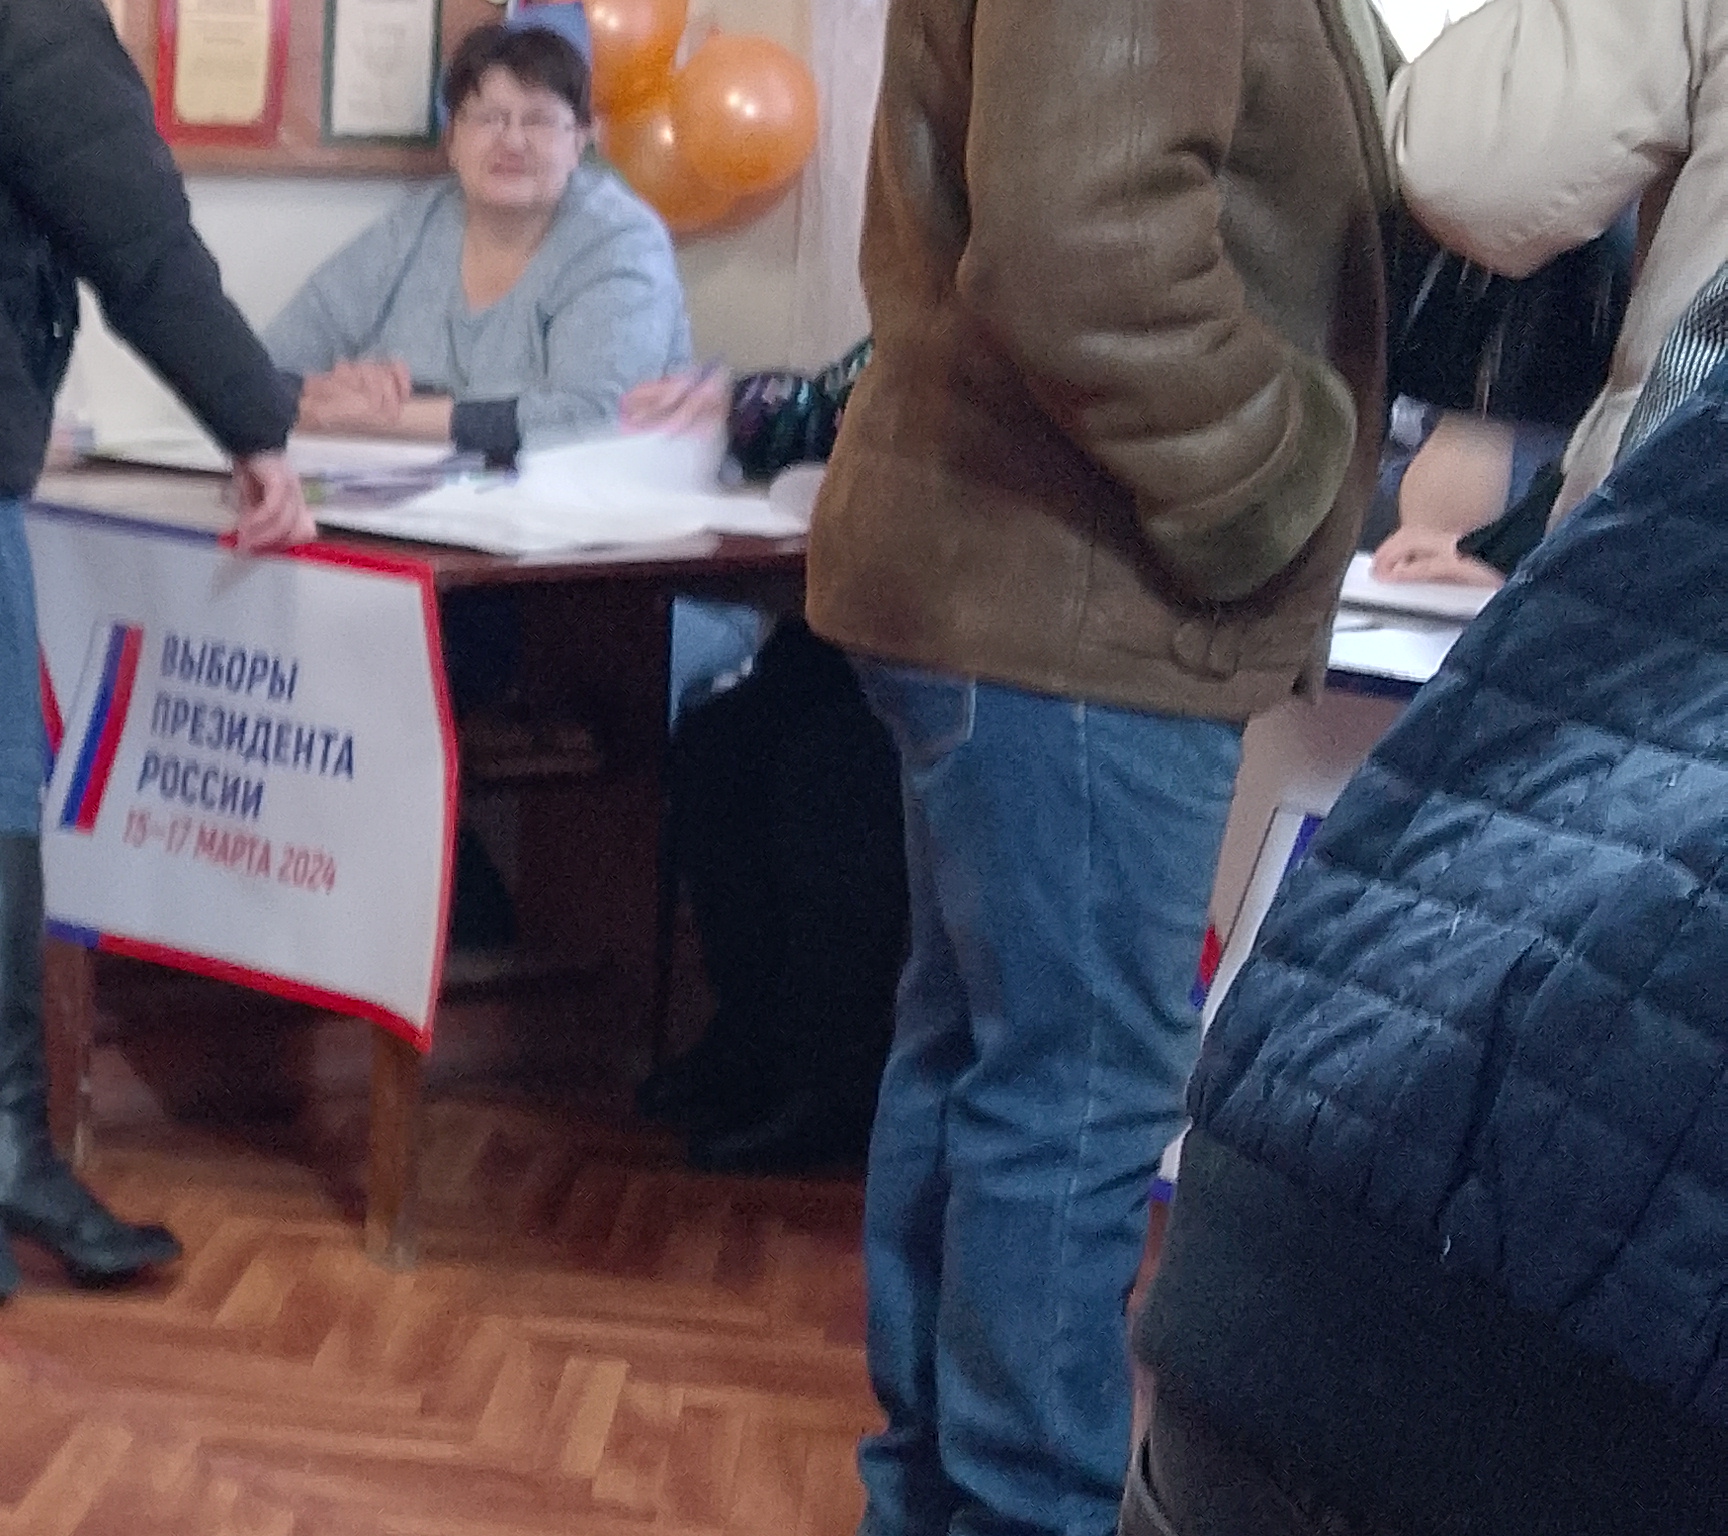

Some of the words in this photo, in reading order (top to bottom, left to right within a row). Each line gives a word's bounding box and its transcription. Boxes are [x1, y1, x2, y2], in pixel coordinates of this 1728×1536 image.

[160, 634, 298, 703] ВЫБОРЫ
[151, 692, 354, 779] ПРЕЗИДЕНТА
[138, 750, 264, 821] РОССИИ
[193, 822, 271, 879] МАРТА
[278, 844, 337, 894] 2024
